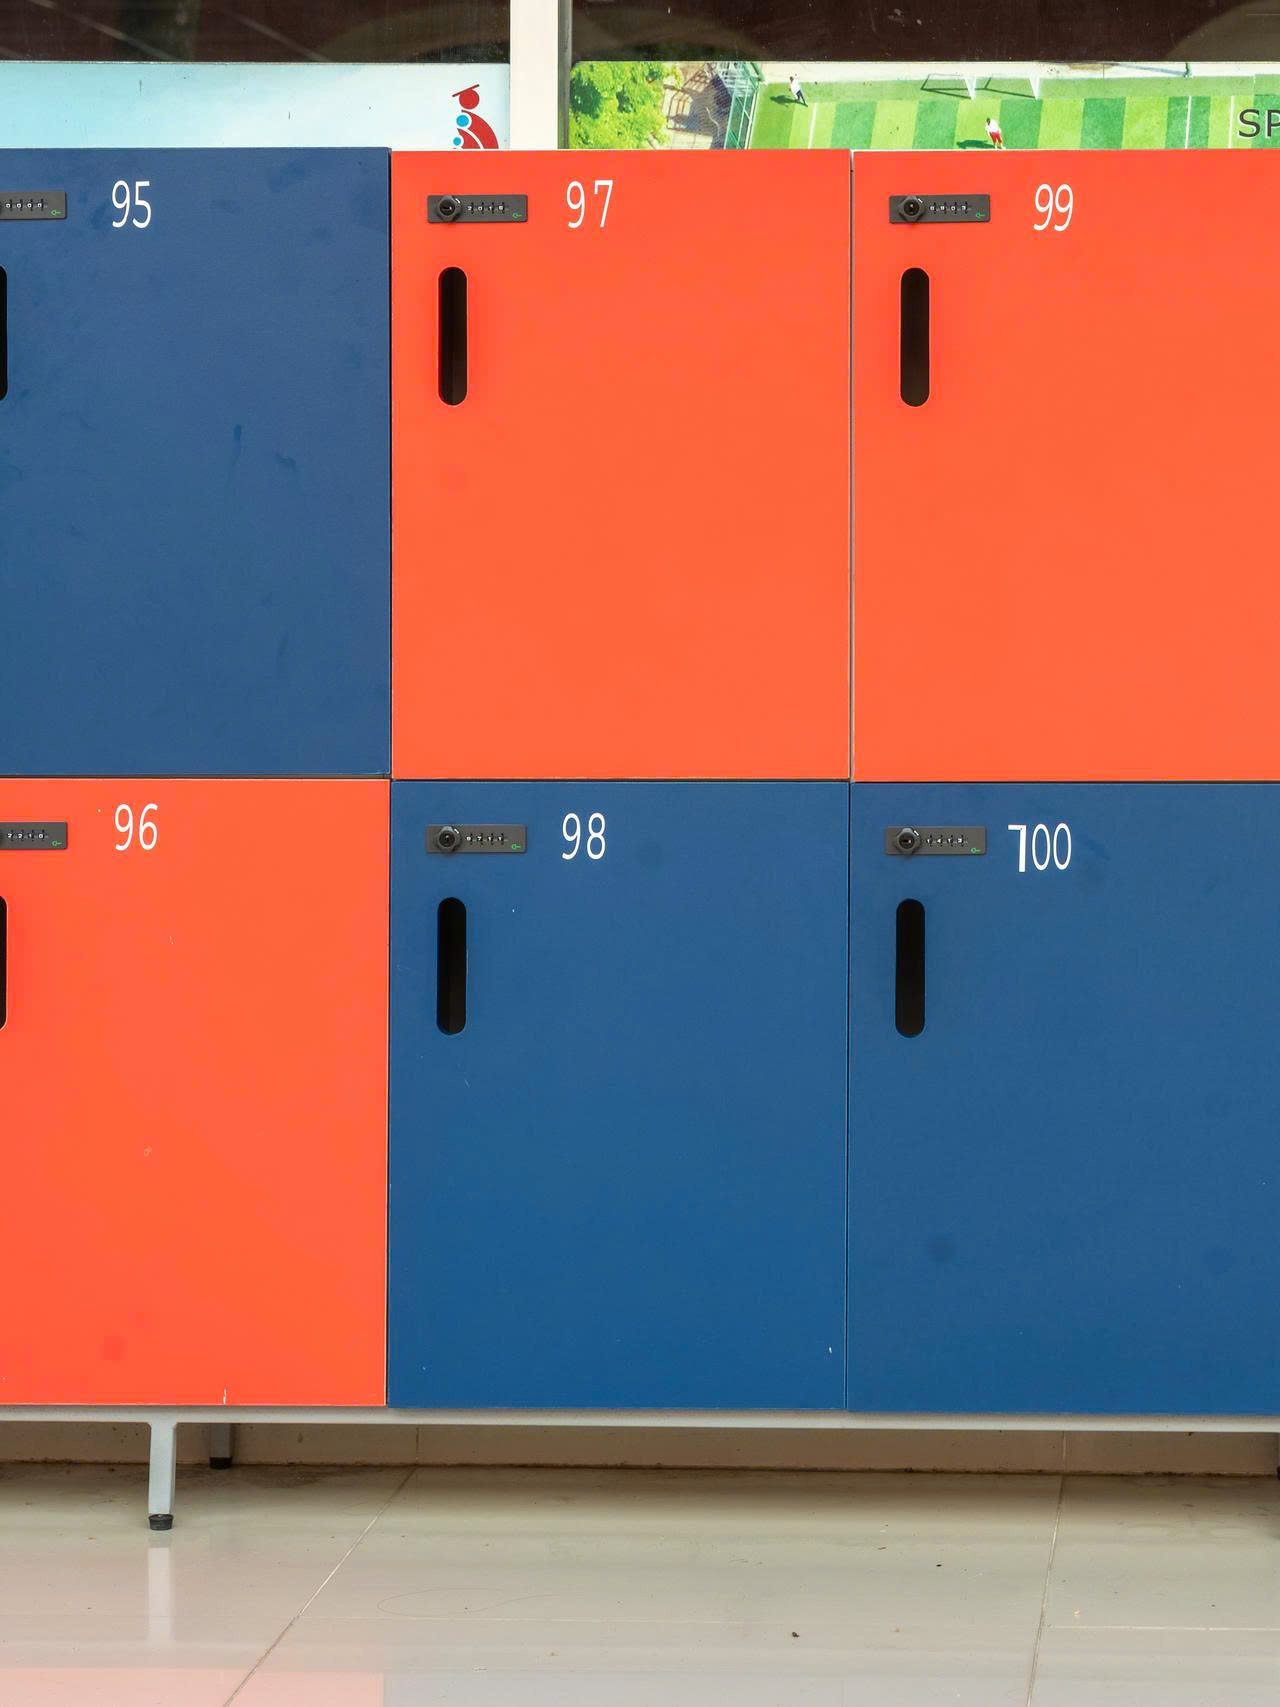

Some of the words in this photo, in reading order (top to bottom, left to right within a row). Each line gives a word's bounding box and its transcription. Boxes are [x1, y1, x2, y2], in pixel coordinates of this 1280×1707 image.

[111, 180, 152, 229] 95
[566, 179, 614, 229] 97
[1033, 183, 1074, 232] 99
[114, 803, 158, 851] 96
[562, 812, 606, 860] 98
[1007, 822, 1072, 873] 100
